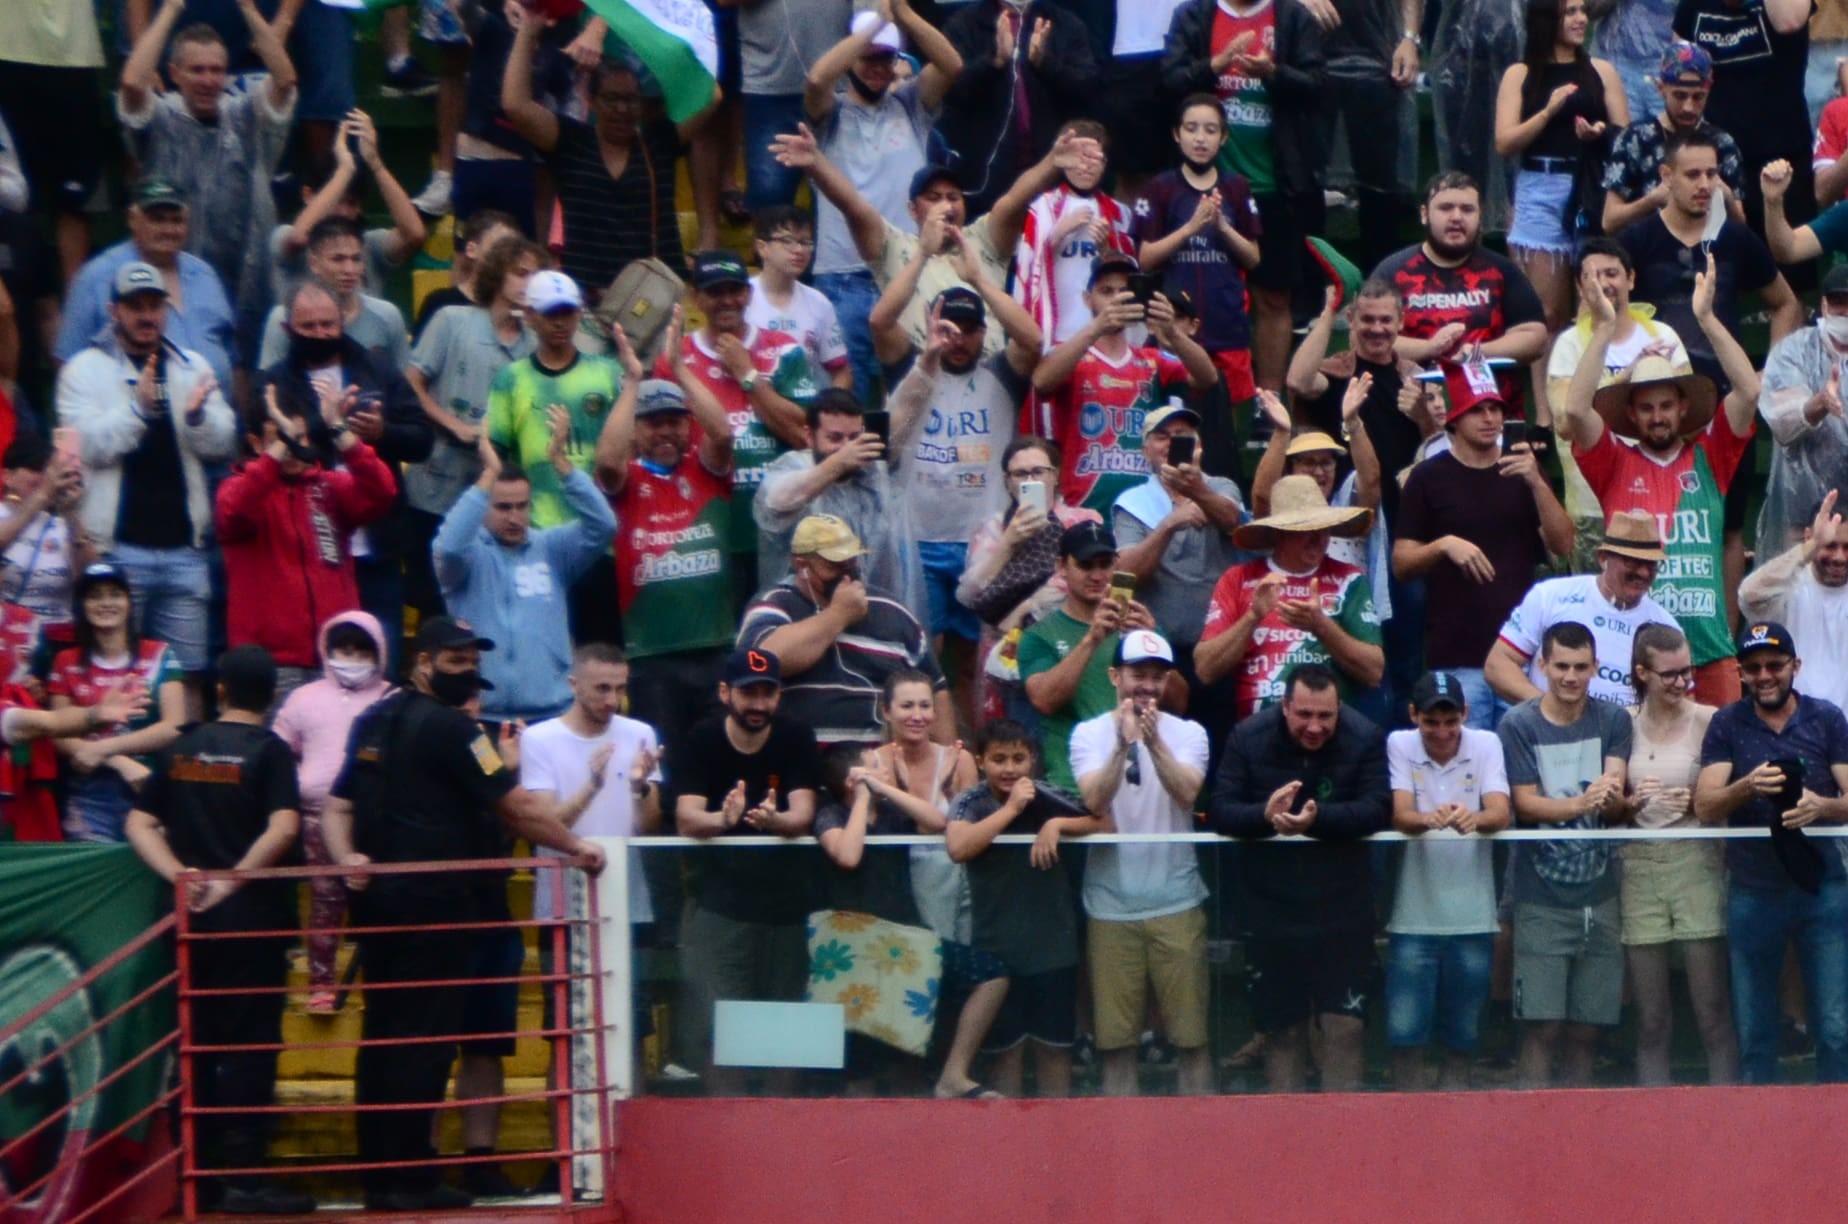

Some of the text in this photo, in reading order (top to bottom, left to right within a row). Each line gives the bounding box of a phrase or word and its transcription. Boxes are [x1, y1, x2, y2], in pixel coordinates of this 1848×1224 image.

[1428, 289, 1491, 310] PENALTY
[1108, 406, 1145, 438] UR
[1075, 444, 1152, 475] Arbaz
[1655, 509, 1711, 544] URI
[633, 548, 721, 586] Arbaza
[1608, 618, 1632, 638] URI
